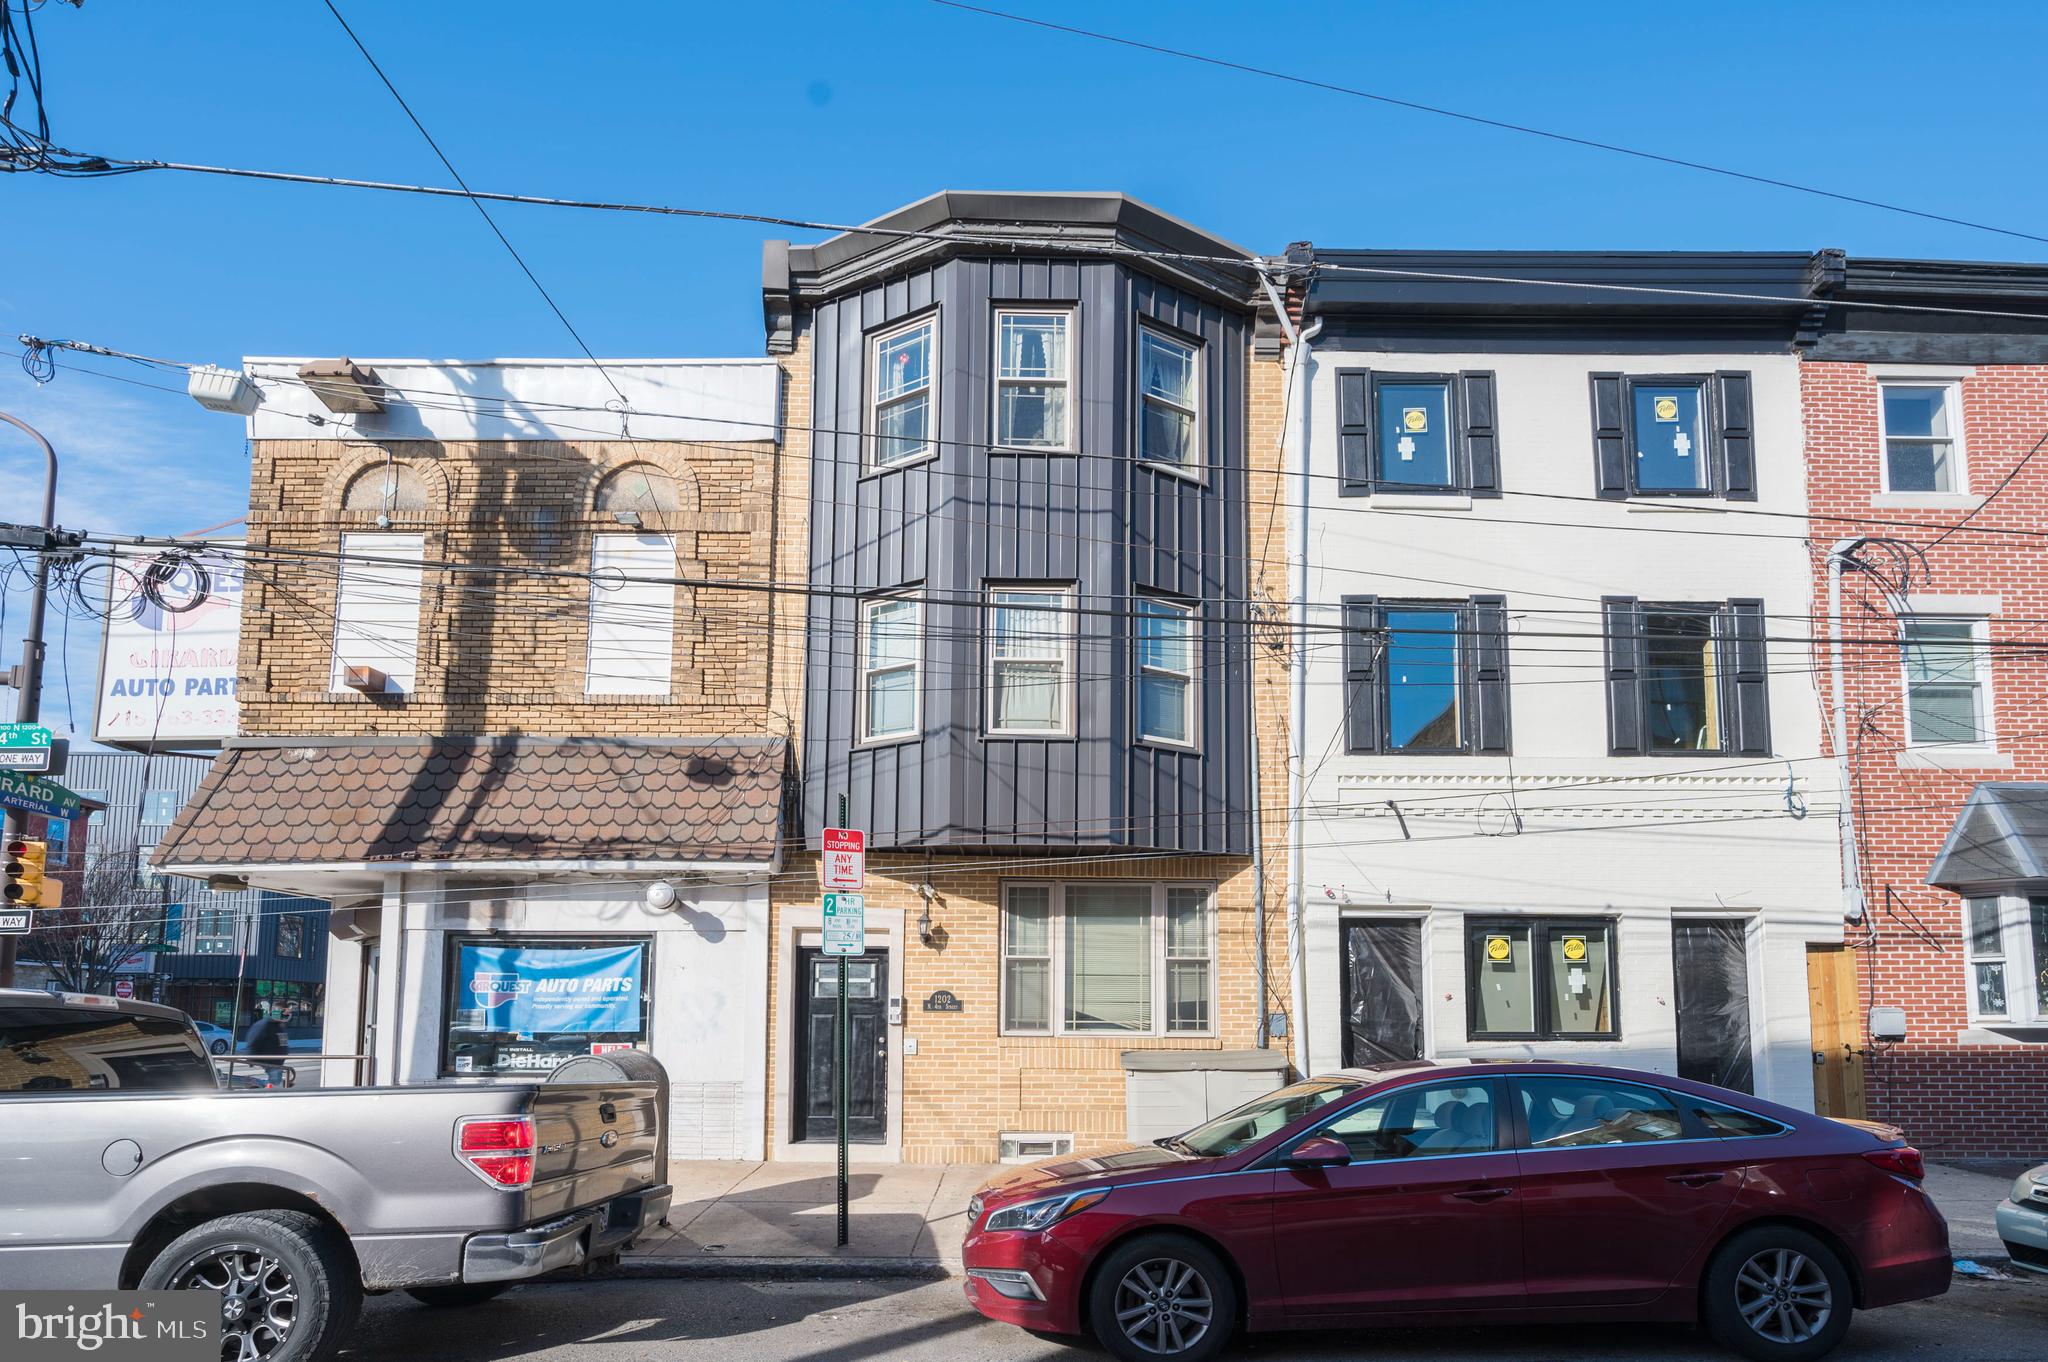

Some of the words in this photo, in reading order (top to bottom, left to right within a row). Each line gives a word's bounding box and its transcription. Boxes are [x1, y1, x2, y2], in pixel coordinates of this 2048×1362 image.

[110, 678, 176, 696] AUTO
[31, 732, 48, 745] St
[21, 755, 41, 763] WAY
[0, 777, 54, 802] RARD
[63, 798, 75, 807] AV
[4, 796, 50, 813] ARTERIAL
[60, 807, 69, 817] W
[838, 831, 849, 840] NO
[826, 840, 860, 850] STOPPING
[835, 854, 853, 863] ANY
[834, 865, 853, 875] TIME
[826, 897, 834, 913] 2
[836, 907, 861, 915] PARKING
[2, 917, 23, 926] WAY
[471, 980, 531, 993] CARQUEST
[535, 978, 579, 993] AUTO
[582, 977, 633, 993] PARTS
[934, 994, 952, 1004] 1202
[497, 1053, 574, 1069] DieHar
